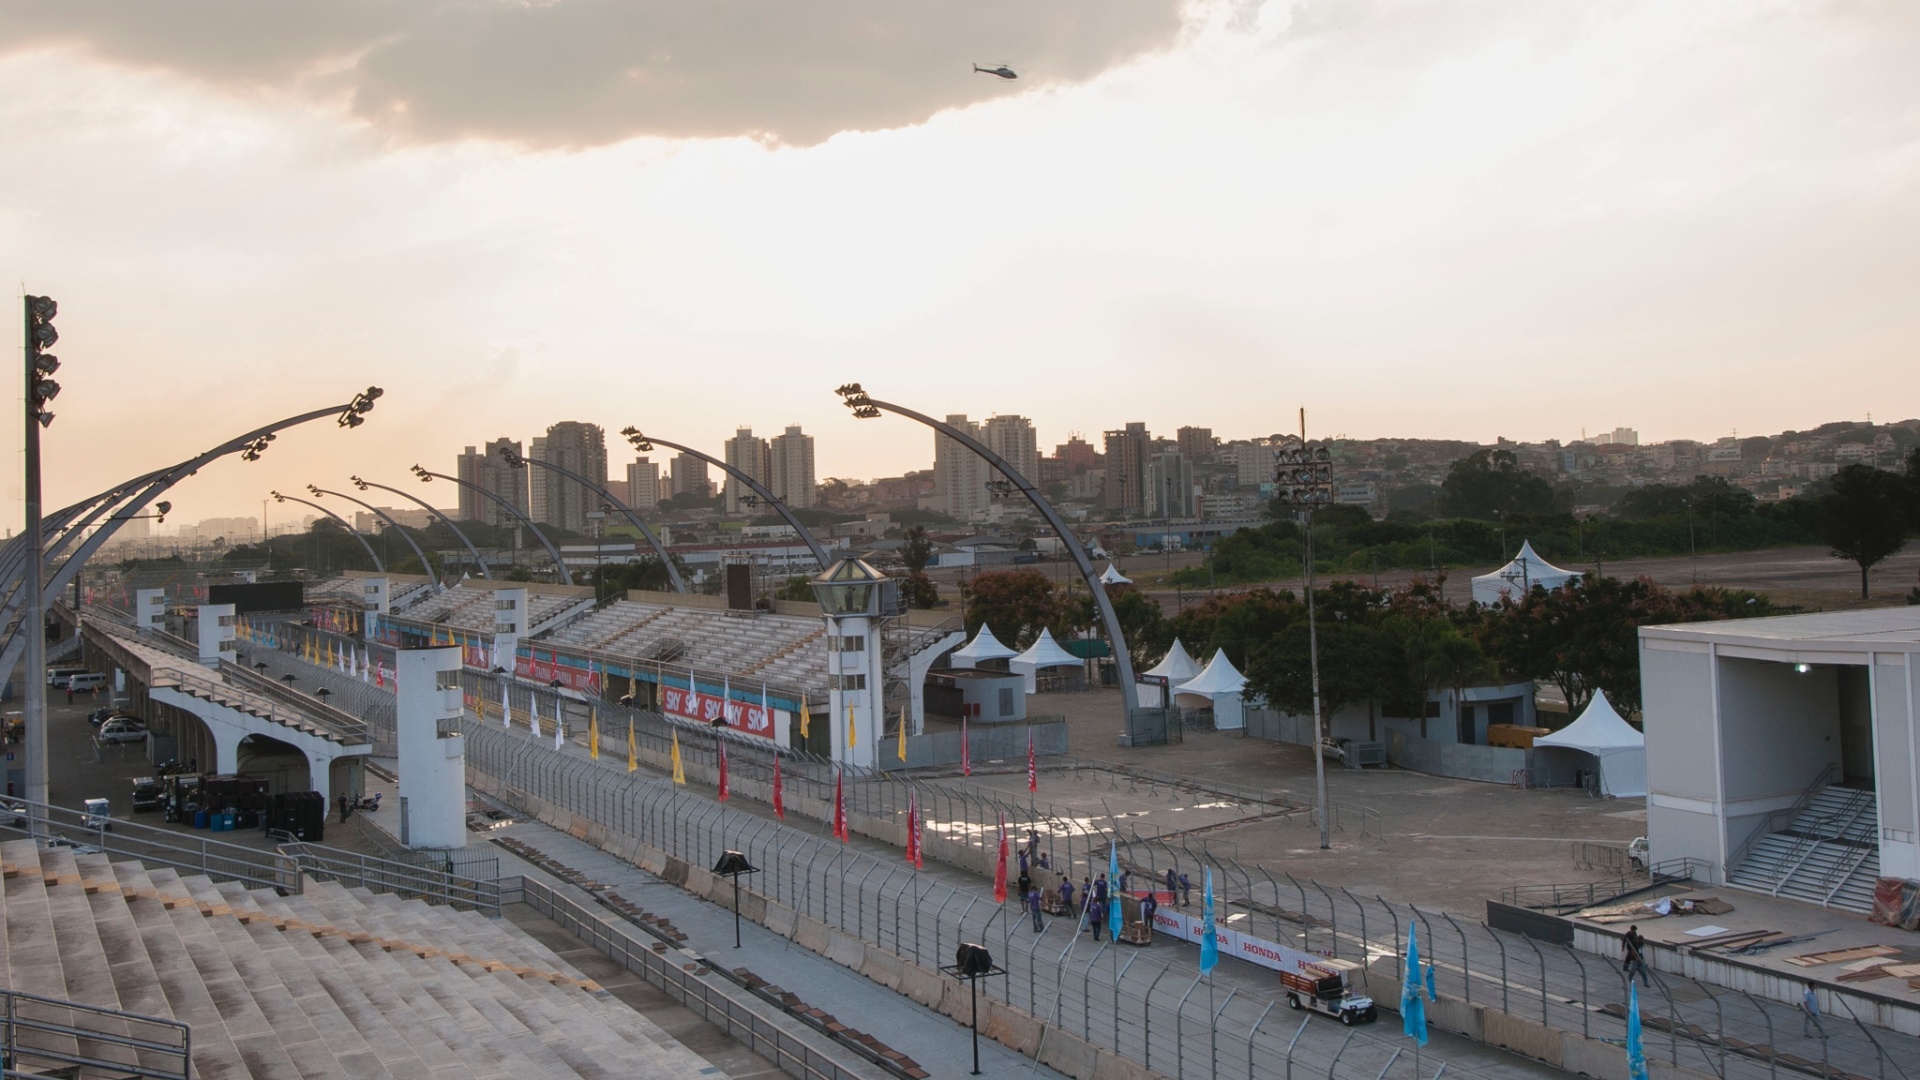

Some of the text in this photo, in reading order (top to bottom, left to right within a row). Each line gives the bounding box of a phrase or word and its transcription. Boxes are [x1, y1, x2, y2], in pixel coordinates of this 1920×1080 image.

[666, 690, 681, 711] SKY
[685, 694, 701, 716] SY
[704, 698, 721, 721] SKY
[1153, 914, 1180, 929] ONDA
[1193, 926, 1229, 946] HODA
[1243, 942, 1282, 962] HONDA
